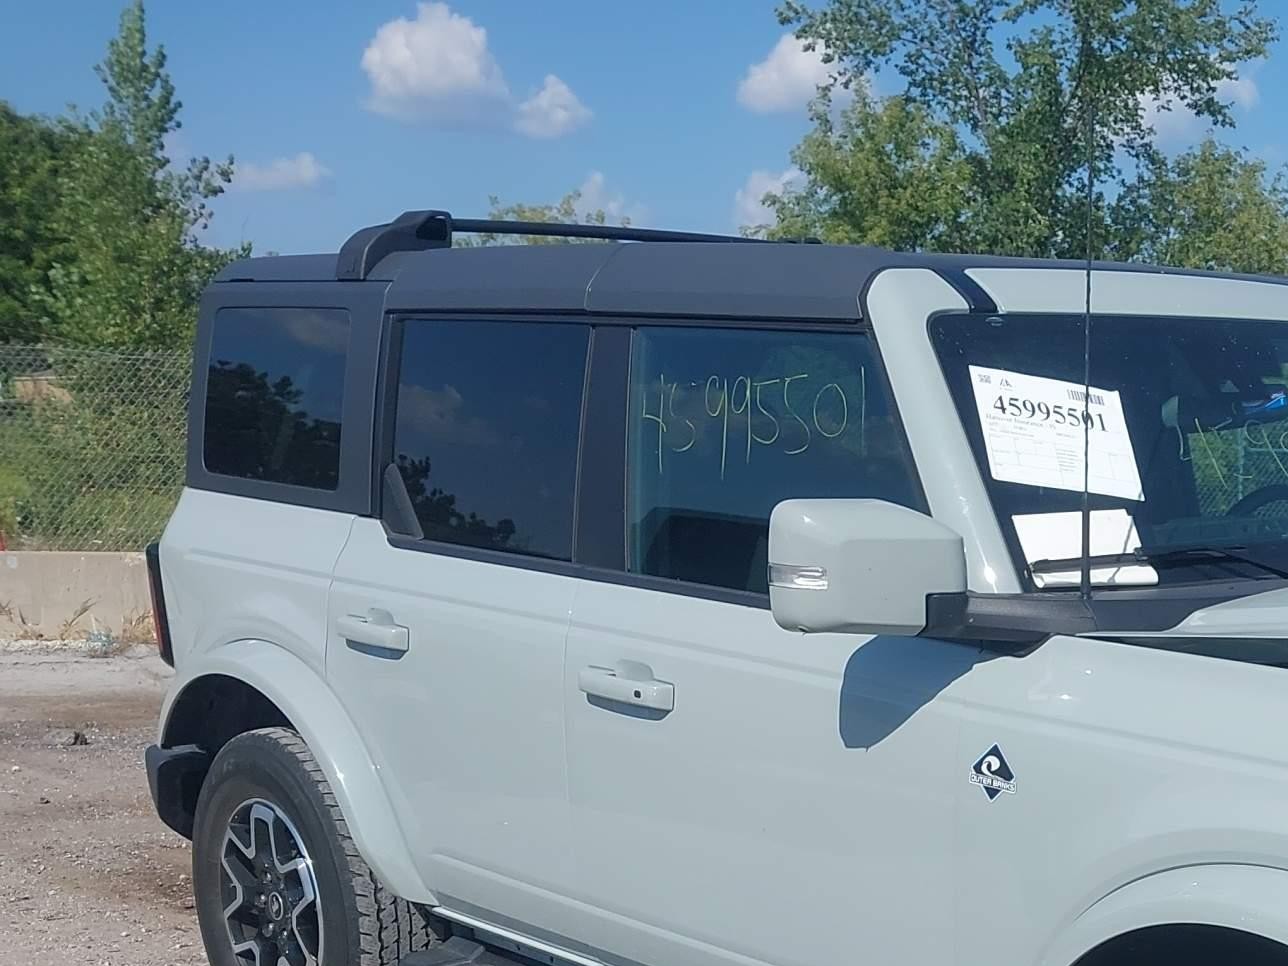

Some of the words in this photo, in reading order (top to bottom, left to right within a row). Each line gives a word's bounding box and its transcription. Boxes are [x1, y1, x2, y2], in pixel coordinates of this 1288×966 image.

[642, 366, 866, 480] 45995501
[993, 395, 1109, 432] 45995501
[992, 779, 1015, 791] BANKS
